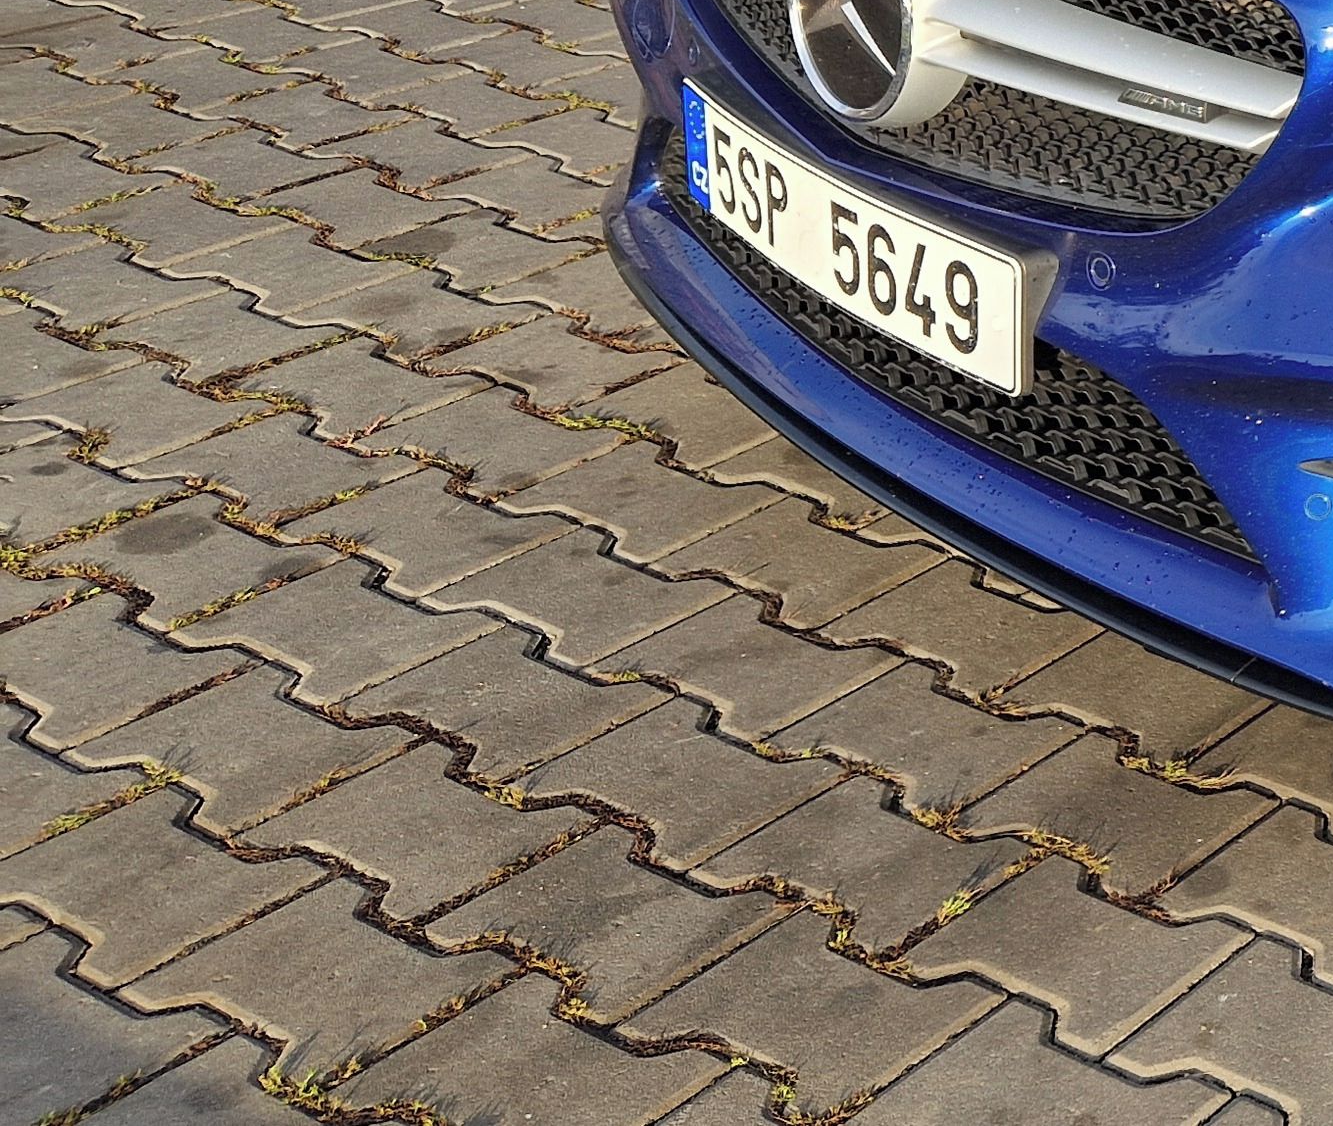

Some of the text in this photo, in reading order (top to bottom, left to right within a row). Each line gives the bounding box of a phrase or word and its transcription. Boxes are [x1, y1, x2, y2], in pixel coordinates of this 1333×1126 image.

[692, 160, 710, 195] CZ
[713, 124, 979, 354] 5SP 5649
